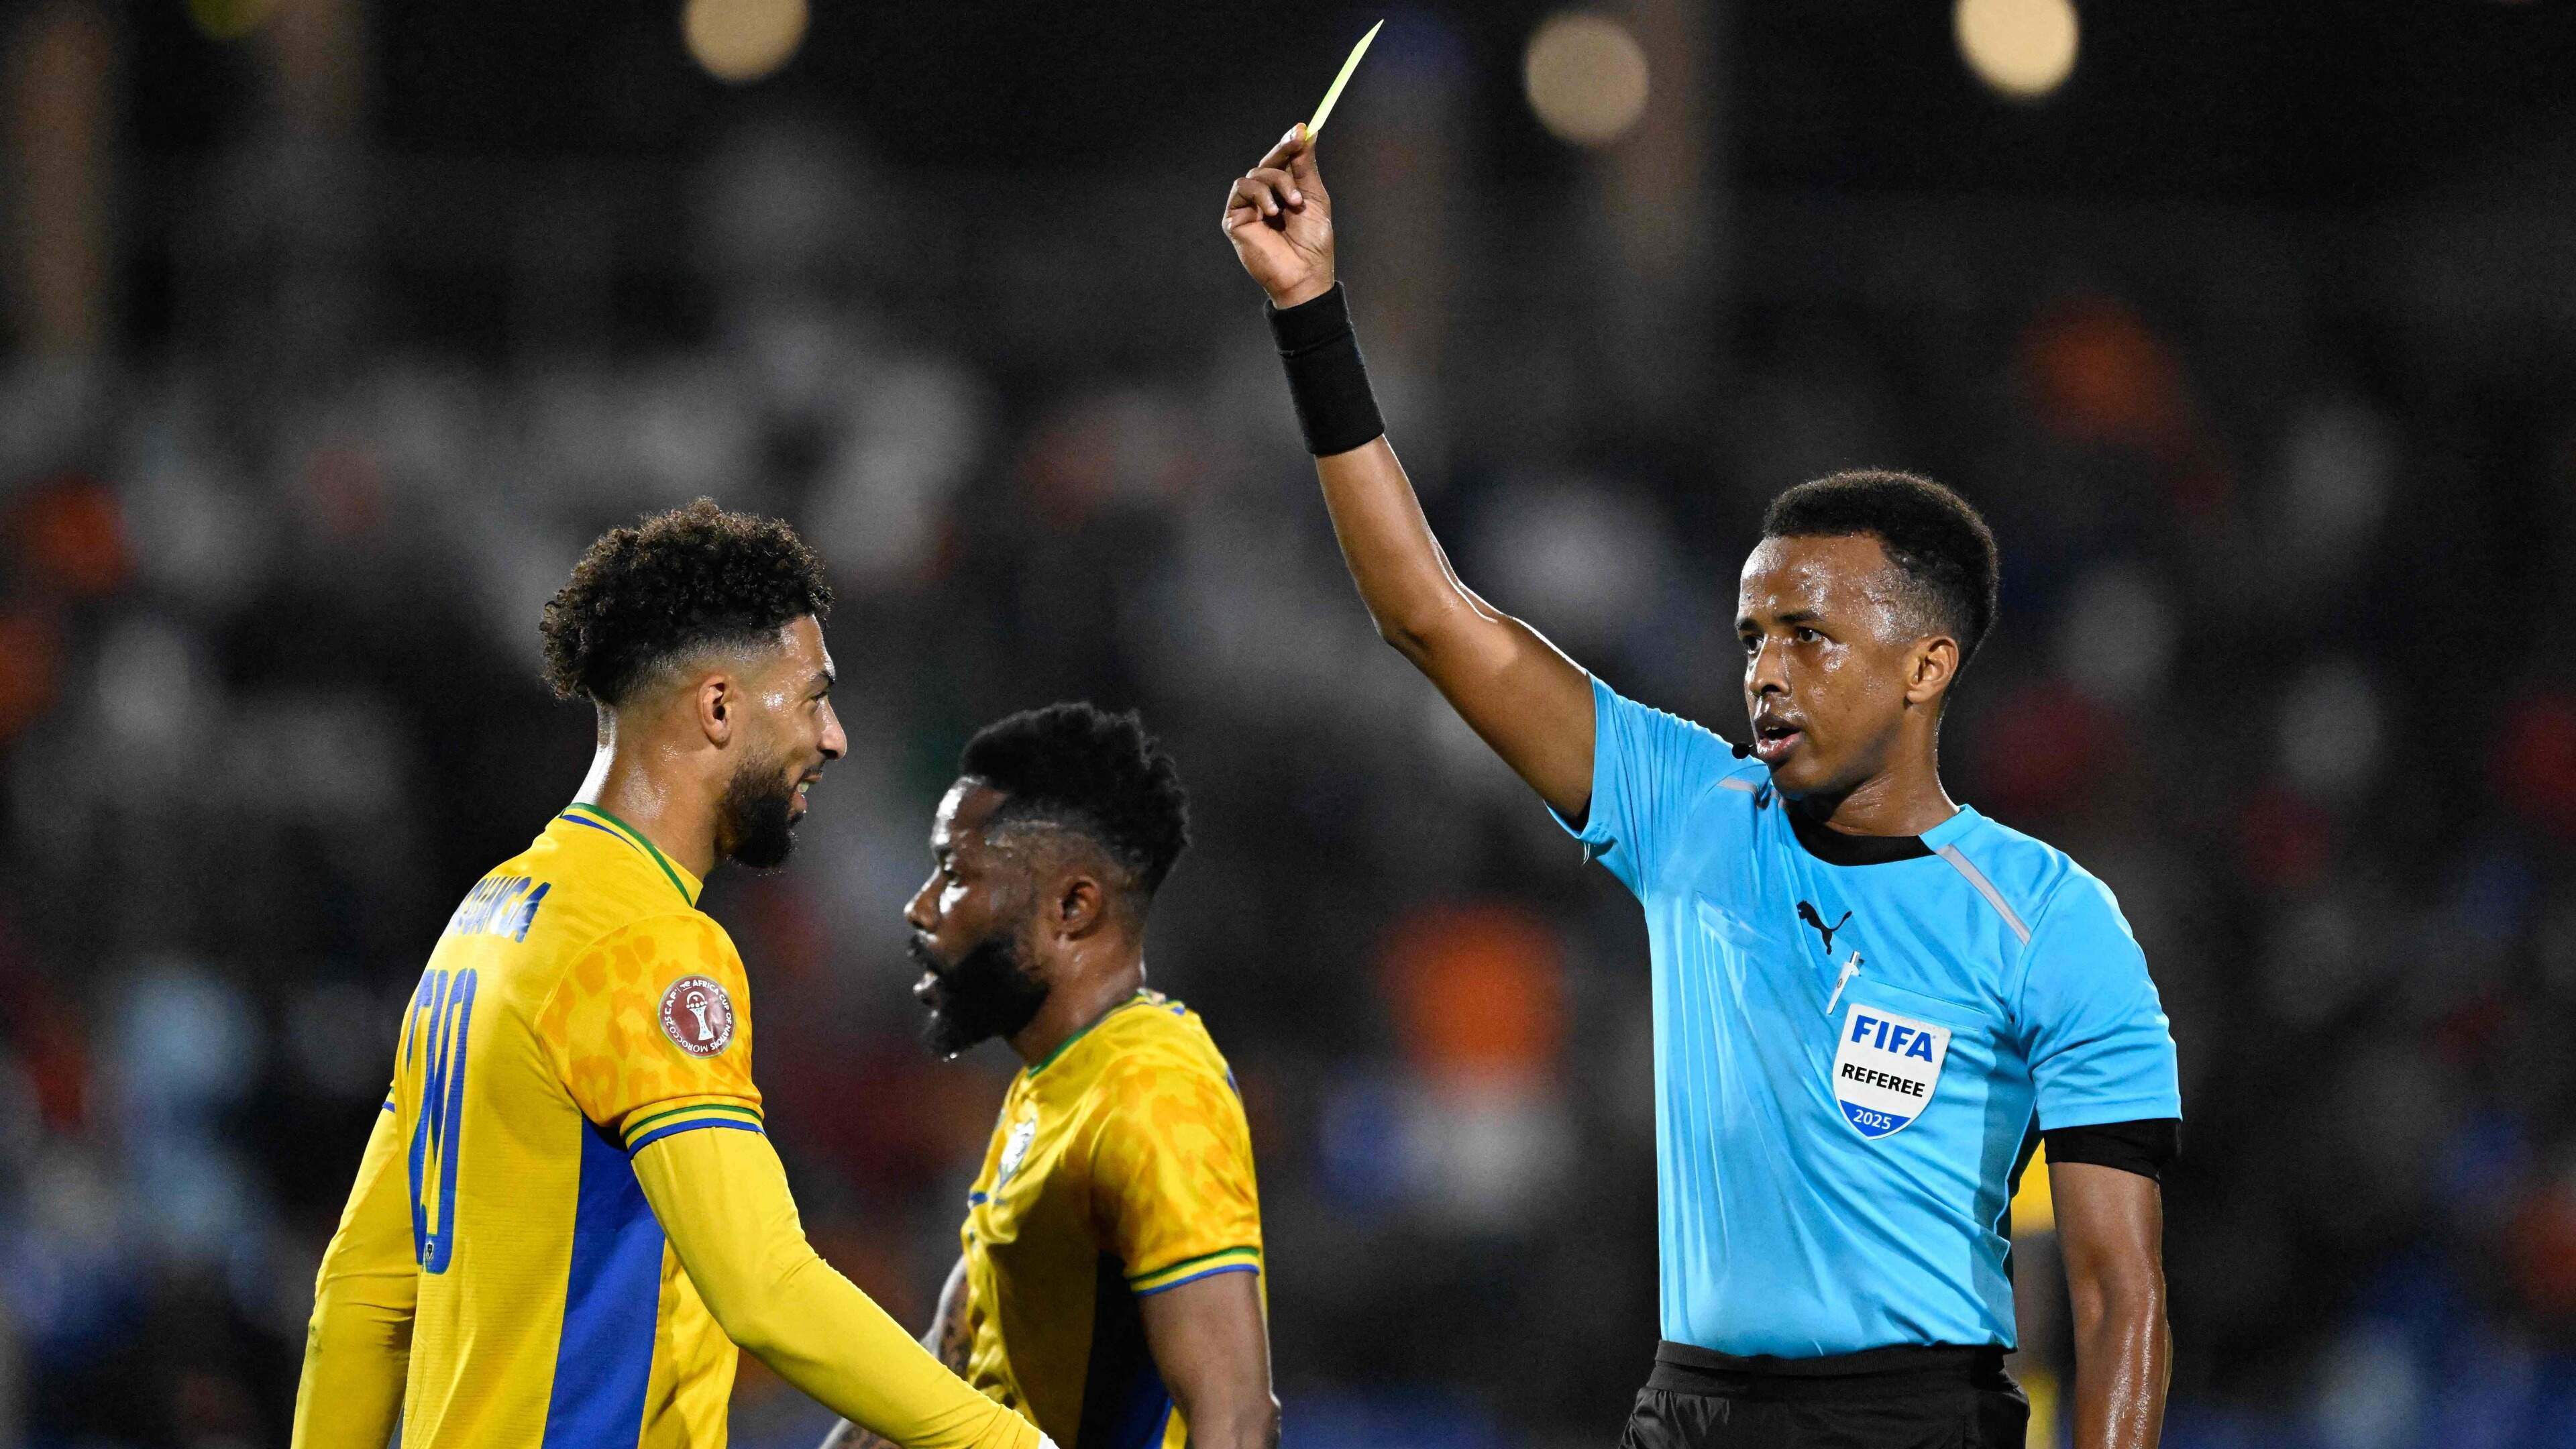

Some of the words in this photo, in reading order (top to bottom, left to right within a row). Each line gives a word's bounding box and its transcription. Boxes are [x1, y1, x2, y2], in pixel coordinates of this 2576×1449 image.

[692, 979, 719, 994] AFRICA
[664, 990, 677, 1014] CAF
[719, 994, 730, 1010] CUP
[664, 1016, 674, 1026] 25
[726, 1012, 732, 1026] OF
[669, 1026, 708, 1052] MOROCCO
[710, 1025, 731, 1051] NATIONS
[1851, 1014, 1933, 1063] FIFA
[1841, 1063, 1925, 1097] REFEREE
[1853, 1109, 1892, 1130] 2025
